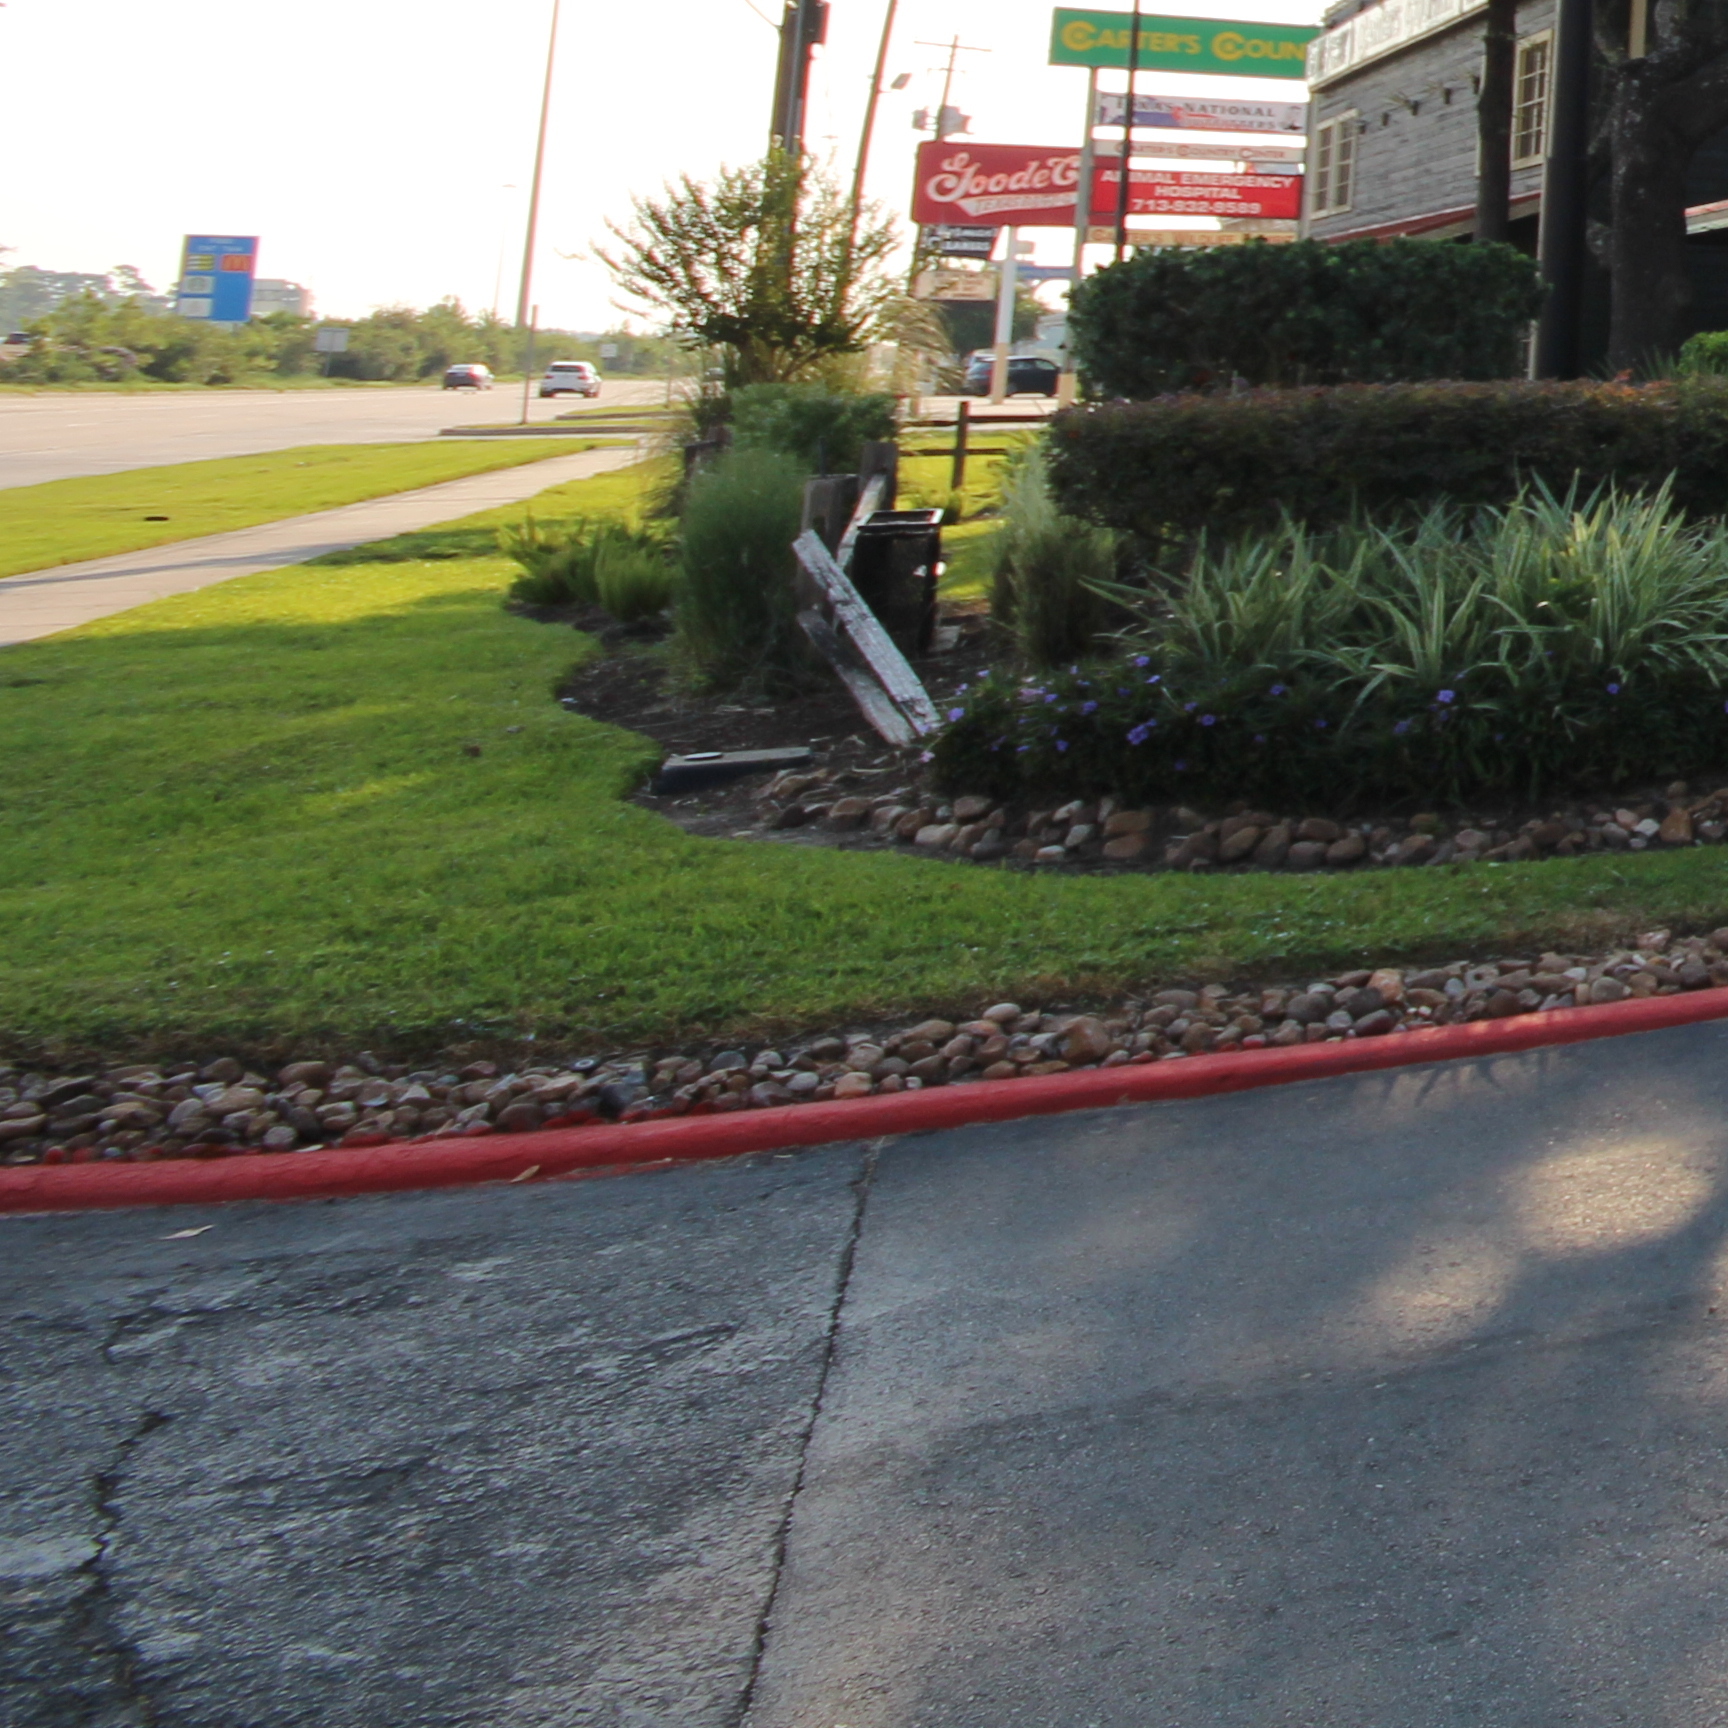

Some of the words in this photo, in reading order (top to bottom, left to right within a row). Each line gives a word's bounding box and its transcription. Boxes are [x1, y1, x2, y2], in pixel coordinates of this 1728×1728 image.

[1211, 31, 1307, 61] COUN
[1184, 102, 1275, 117] NATIONAL
[1181, 173, 1295, 188] EMERGENCY
[1154, 185, 1243, 199] HOSPITAL
